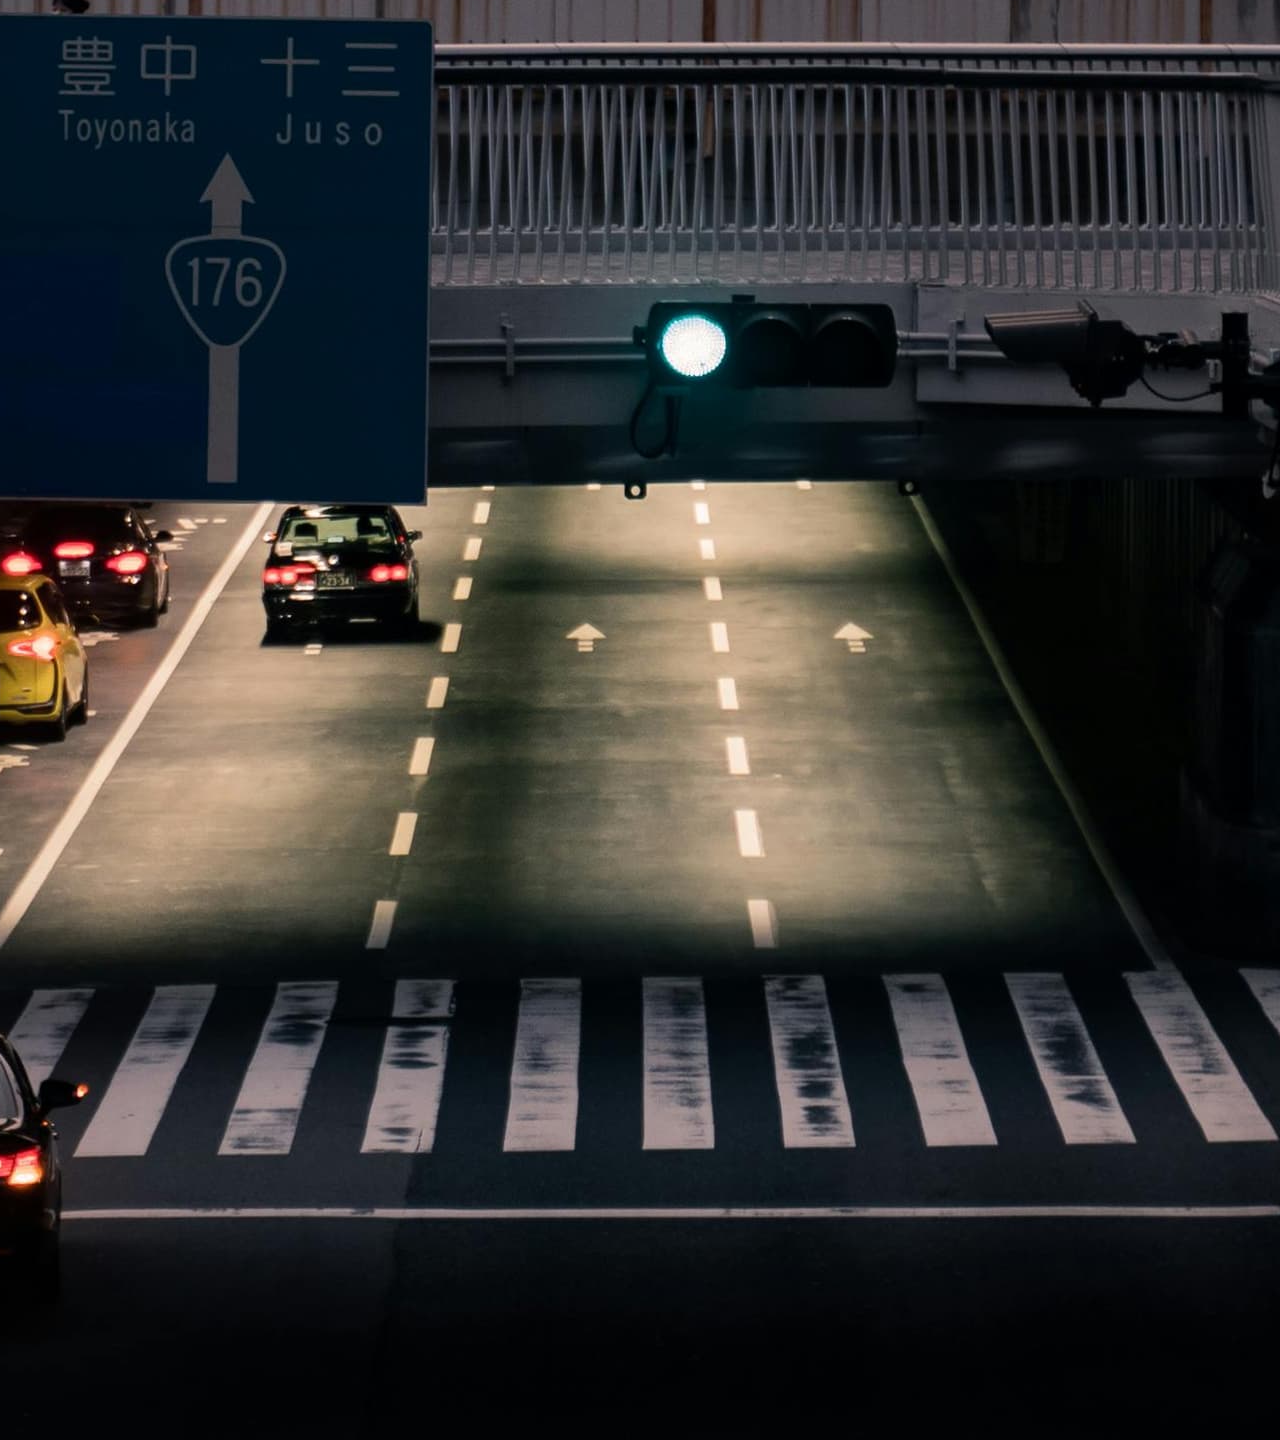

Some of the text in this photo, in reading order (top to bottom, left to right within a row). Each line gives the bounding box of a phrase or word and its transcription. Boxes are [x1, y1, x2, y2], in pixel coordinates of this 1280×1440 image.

[58, 35, 400, 98] 豊中 十三
[58, 110, 383, 149] Toyonaka Juso
[187, 257, 263, 307] 176
